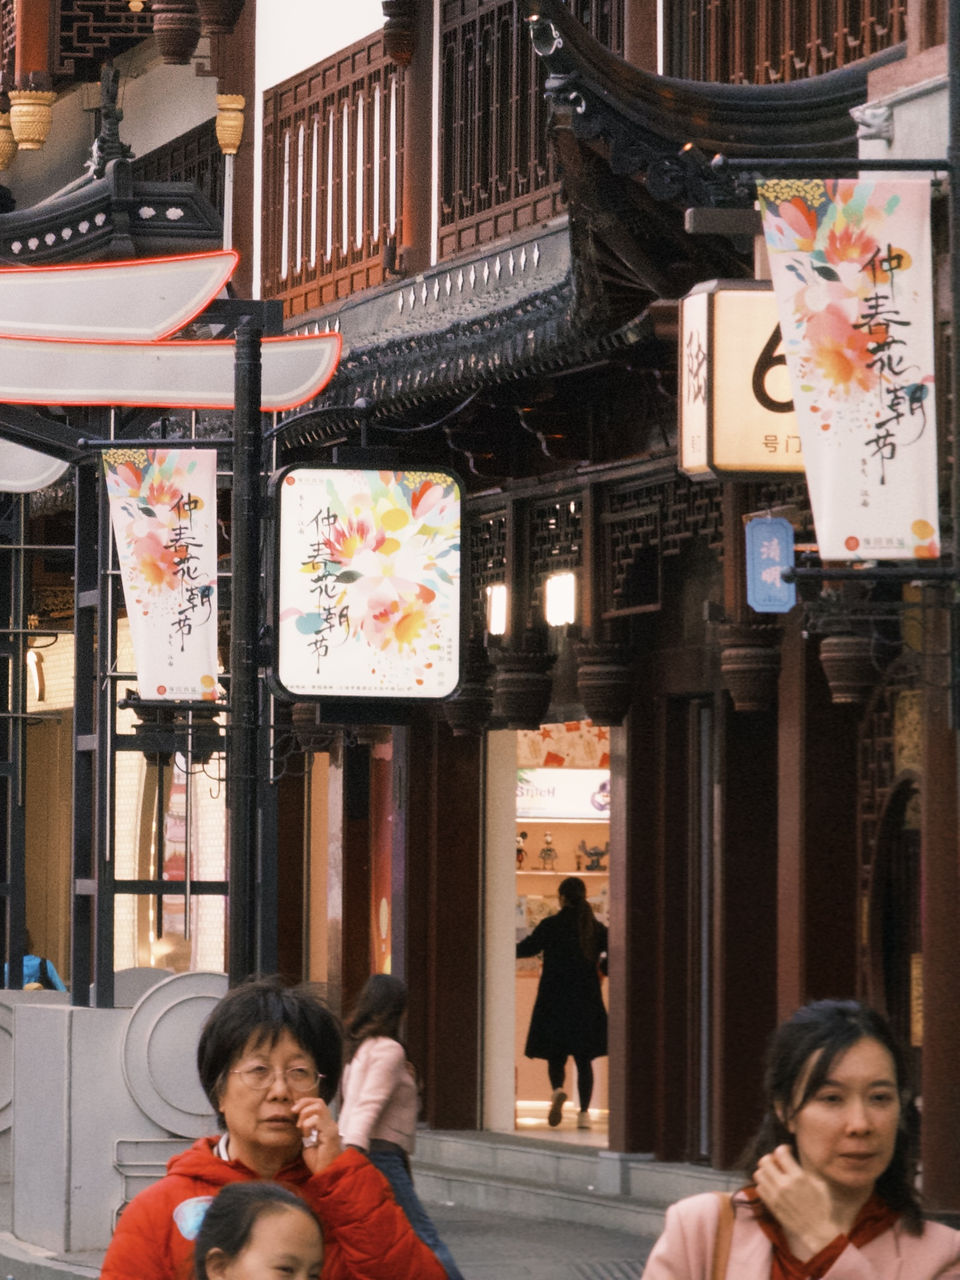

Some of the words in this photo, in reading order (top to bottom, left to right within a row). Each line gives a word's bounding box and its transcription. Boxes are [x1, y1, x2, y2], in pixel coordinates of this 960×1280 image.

[752, 321, 795, 414] 6
[762, 434, 803, 454] 号门
[853, 243, 927, 486] 仲春花朝节
[164, 492, 212, 652] 仲春花朝节
[301, 506, 350, 675] 仲春花朝节
